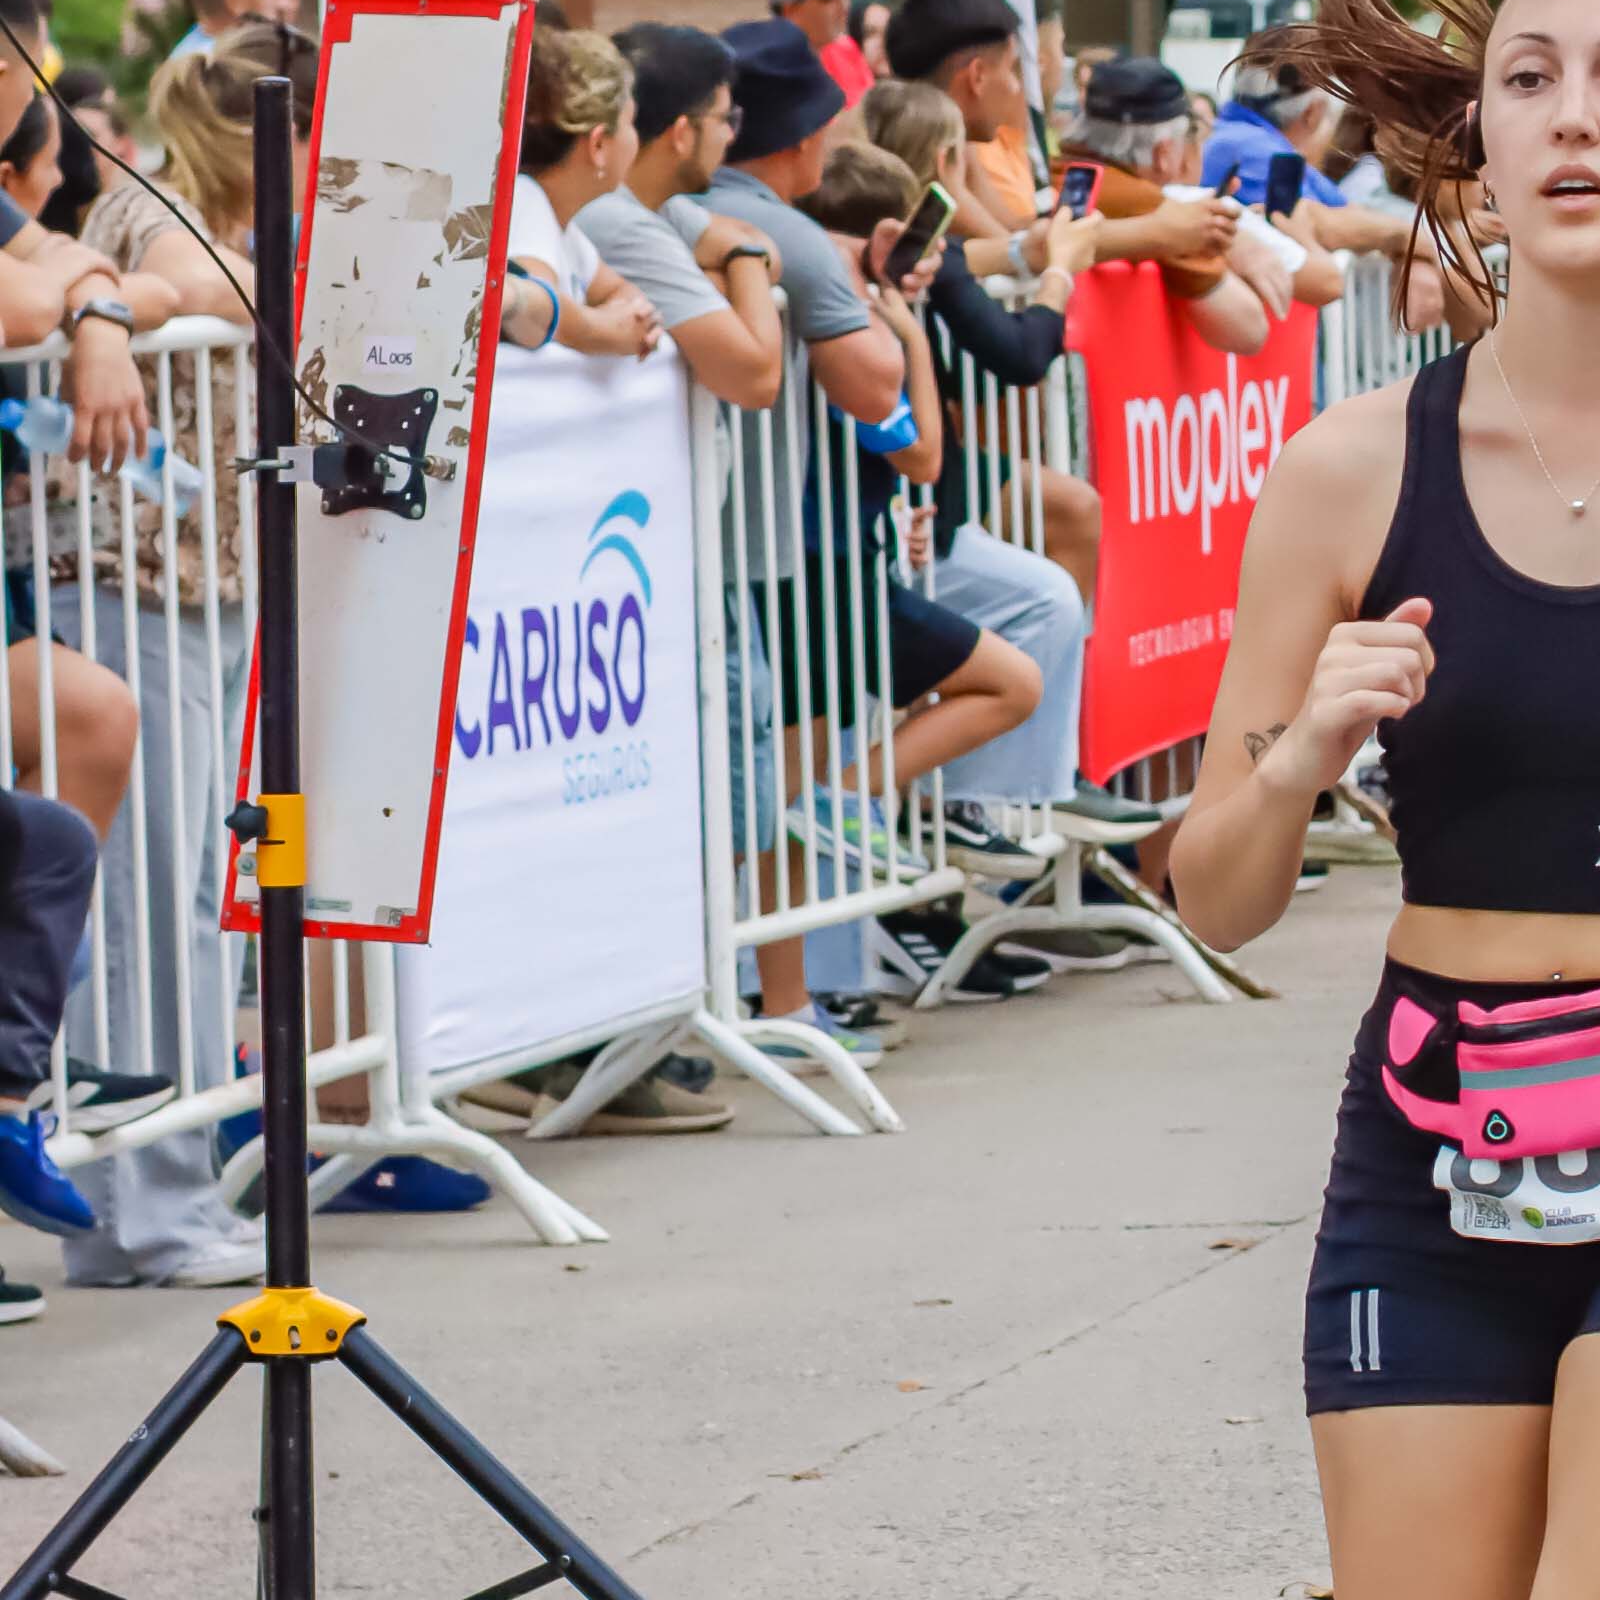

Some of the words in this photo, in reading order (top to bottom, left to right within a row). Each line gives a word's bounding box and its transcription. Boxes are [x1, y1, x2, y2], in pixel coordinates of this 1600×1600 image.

[1124, 351, 1289, 555] moplex
[454, 592, 646, 759] CARUSO
[562, 738, 652, 807] SEGUROS
